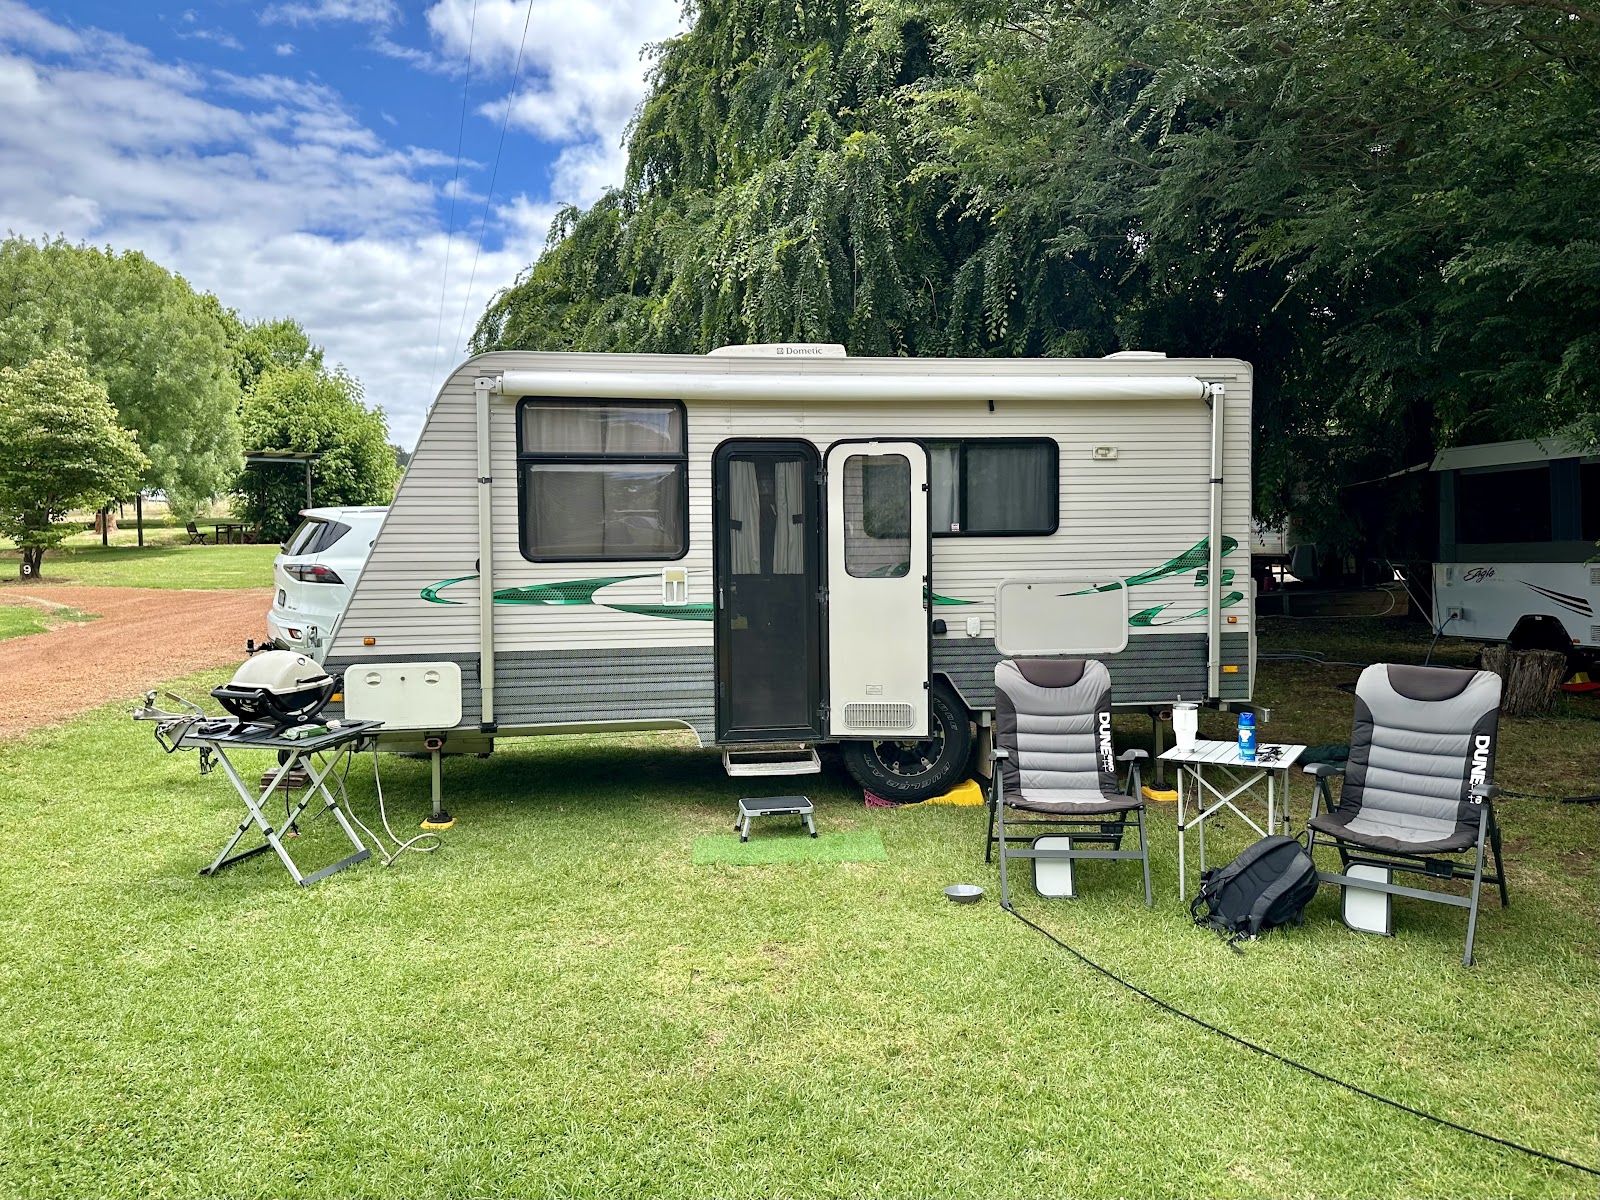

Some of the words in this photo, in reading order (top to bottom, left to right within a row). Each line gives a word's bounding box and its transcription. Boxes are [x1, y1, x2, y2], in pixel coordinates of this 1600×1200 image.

[786, 347, 823, 355] Dometic
[23, 564, 32, 575] 9
[1193, 569, 1236, 587] 52
[1463, 566, 1496, 583] Eagle
[1098, 712, 1113, 755] DUNE
[1469, 735, 1491, 785] DUNE
